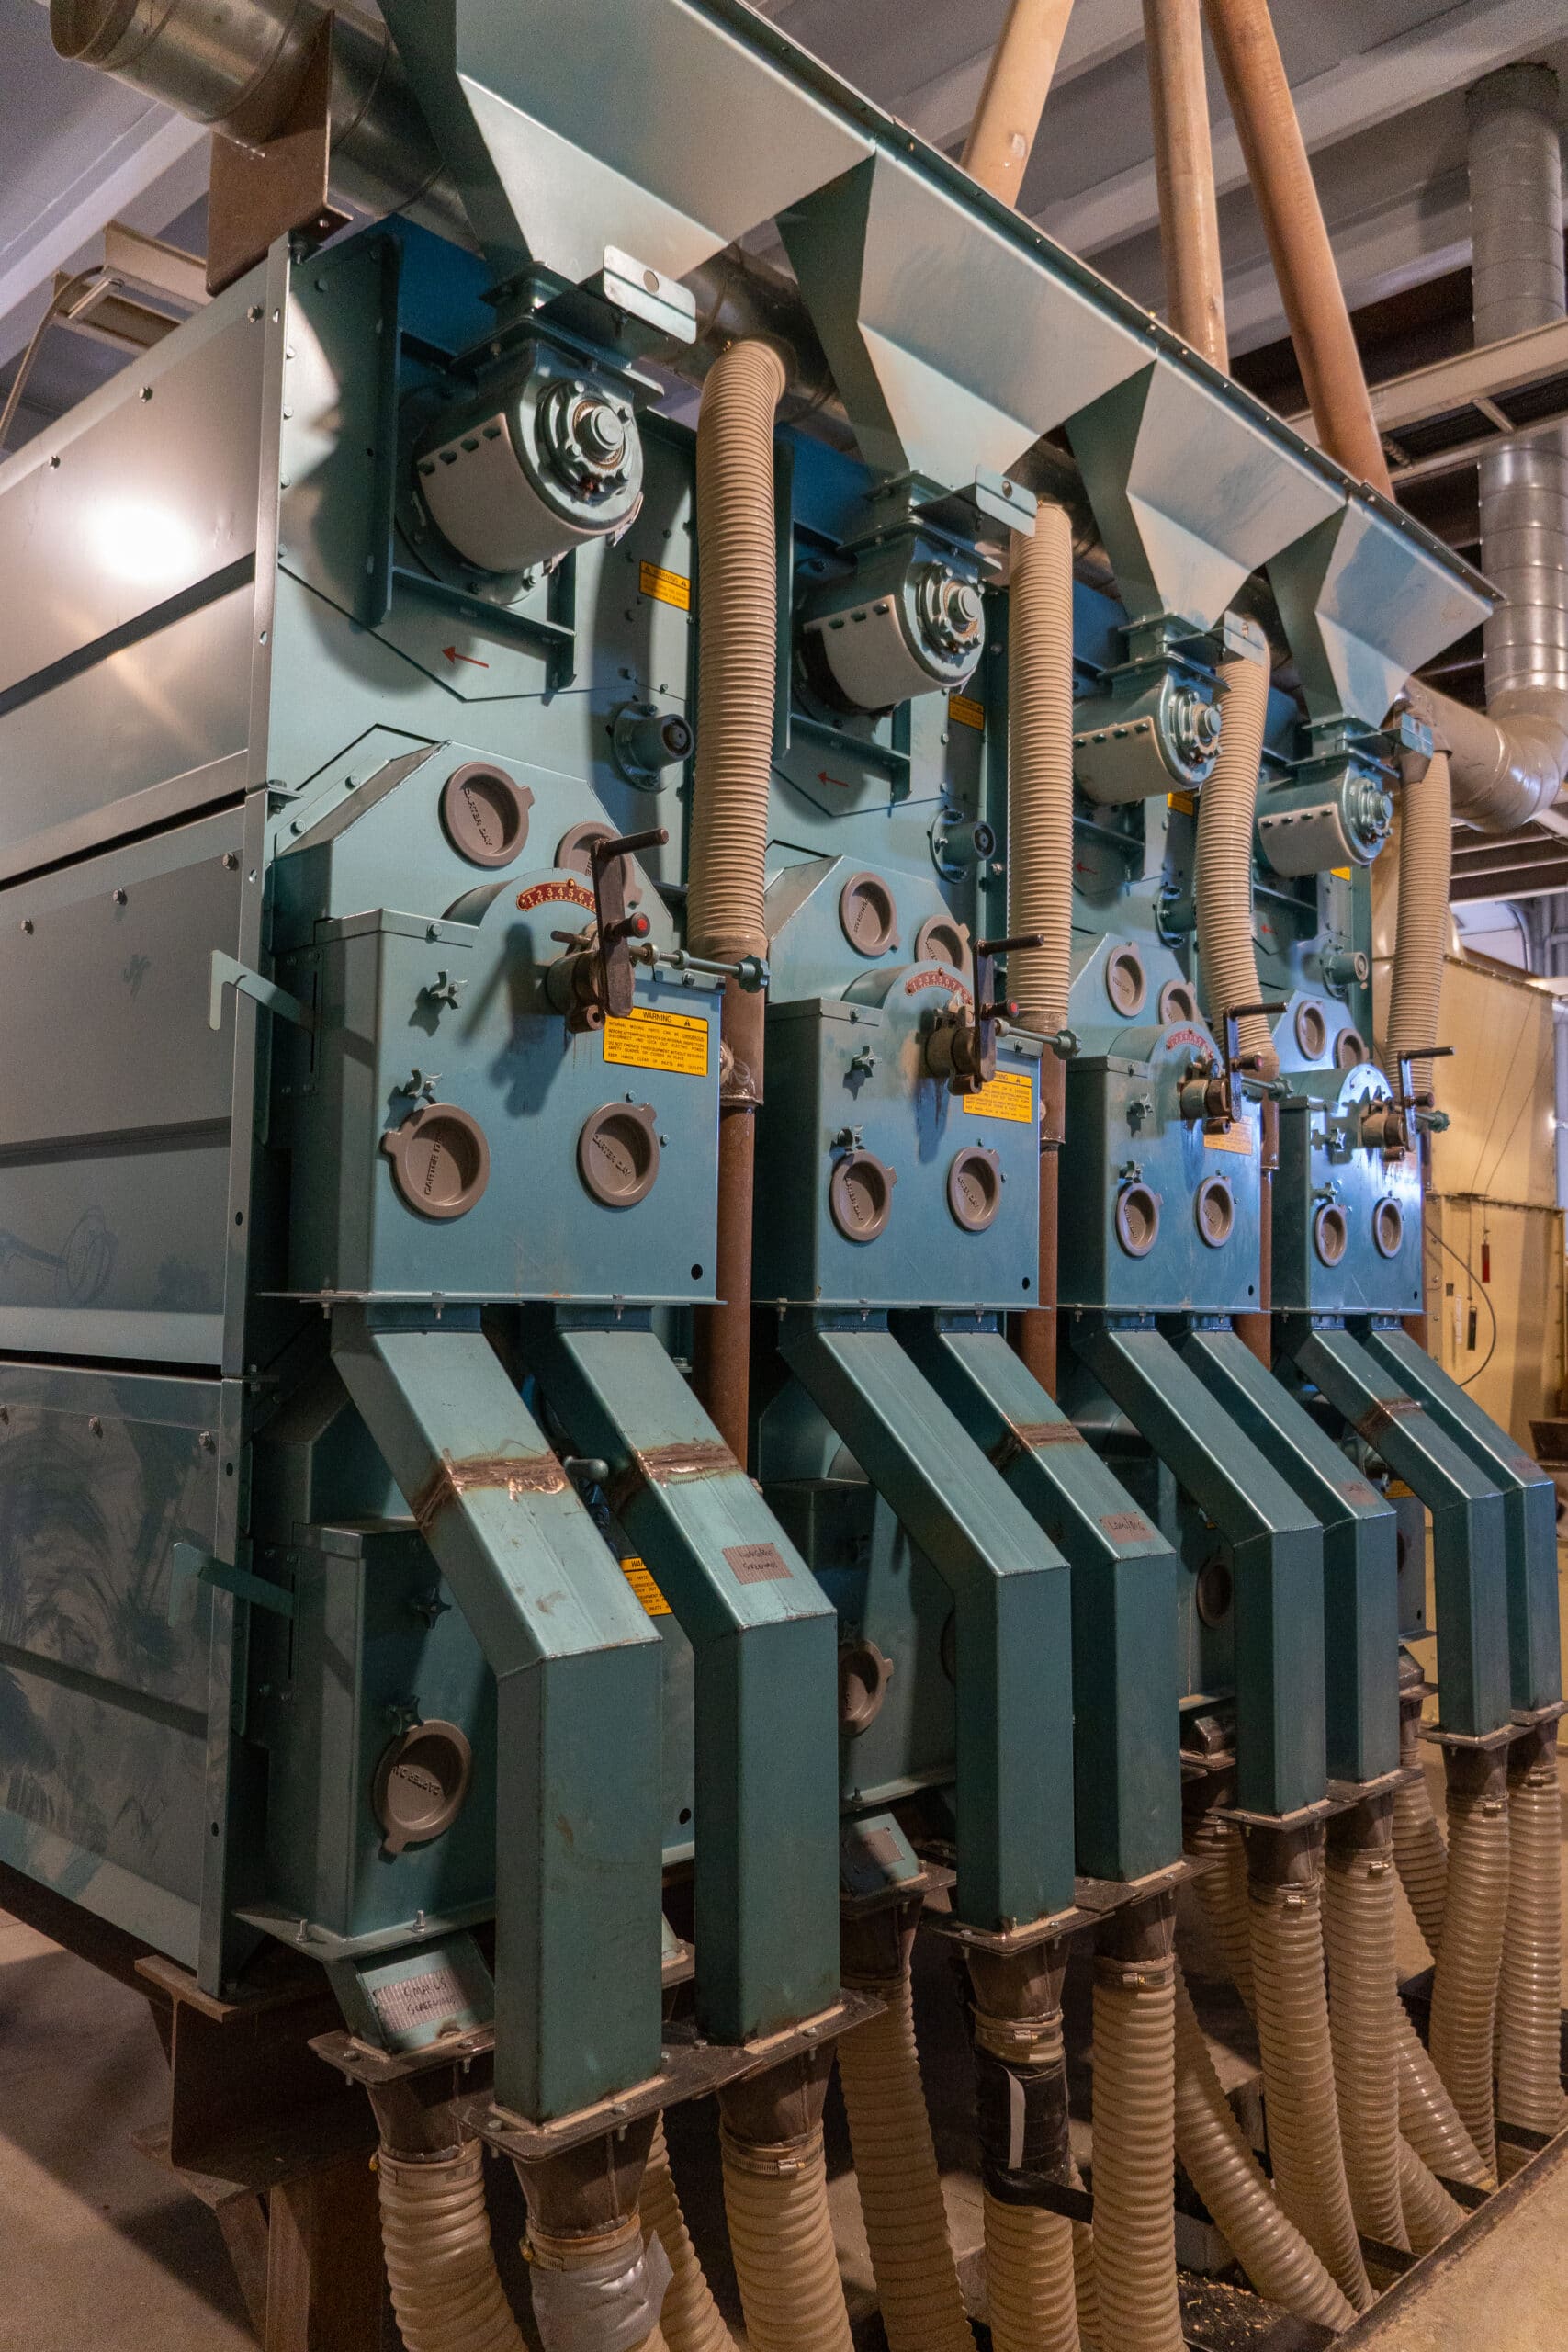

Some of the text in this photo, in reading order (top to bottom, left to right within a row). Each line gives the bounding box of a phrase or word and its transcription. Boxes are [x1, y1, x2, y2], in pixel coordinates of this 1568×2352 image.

[536, 890, 543, 899] 2
[547, 888, 553, 897] 3
[558, 888, 564, 897] 4
[568, 888, 574, 898] 5
[579, 892, 584, 900] 6
[589, 897, 595, 905] 7
[643, 1012, 672, 1023] WARNING
